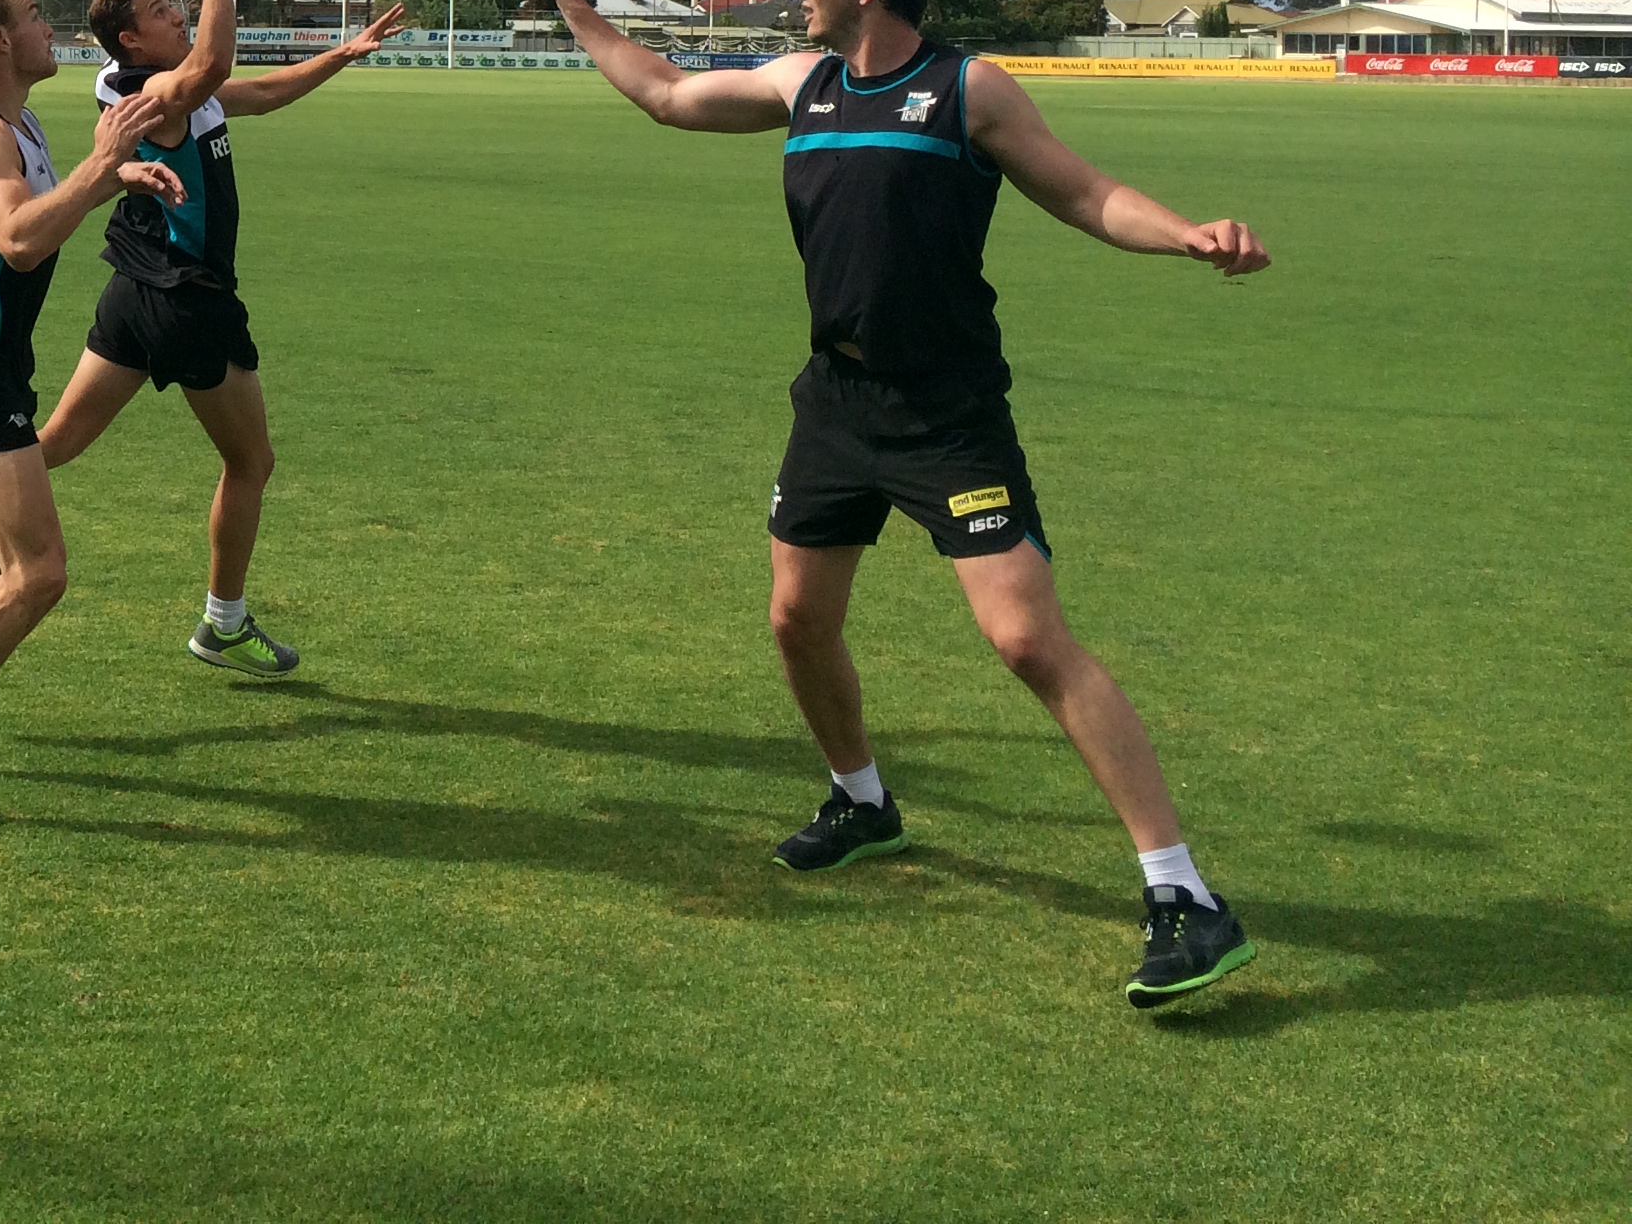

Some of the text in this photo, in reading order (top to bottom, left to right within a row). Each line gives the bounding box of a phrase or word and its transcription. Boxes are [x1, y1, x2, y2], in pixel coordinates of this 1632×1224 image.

[236, 31, 329, 42] maughan thiem
[671, 55, 710, 68] Signs
[1051, 62, 1090, 70] RENAULT
[1194, 63, 1235, 71] RENAULT
[1243, 64, 1283, 72] RENAULT
[1290, 65, 1331, 73] RENAULT
[971, 490, 1004, 502] hunger
